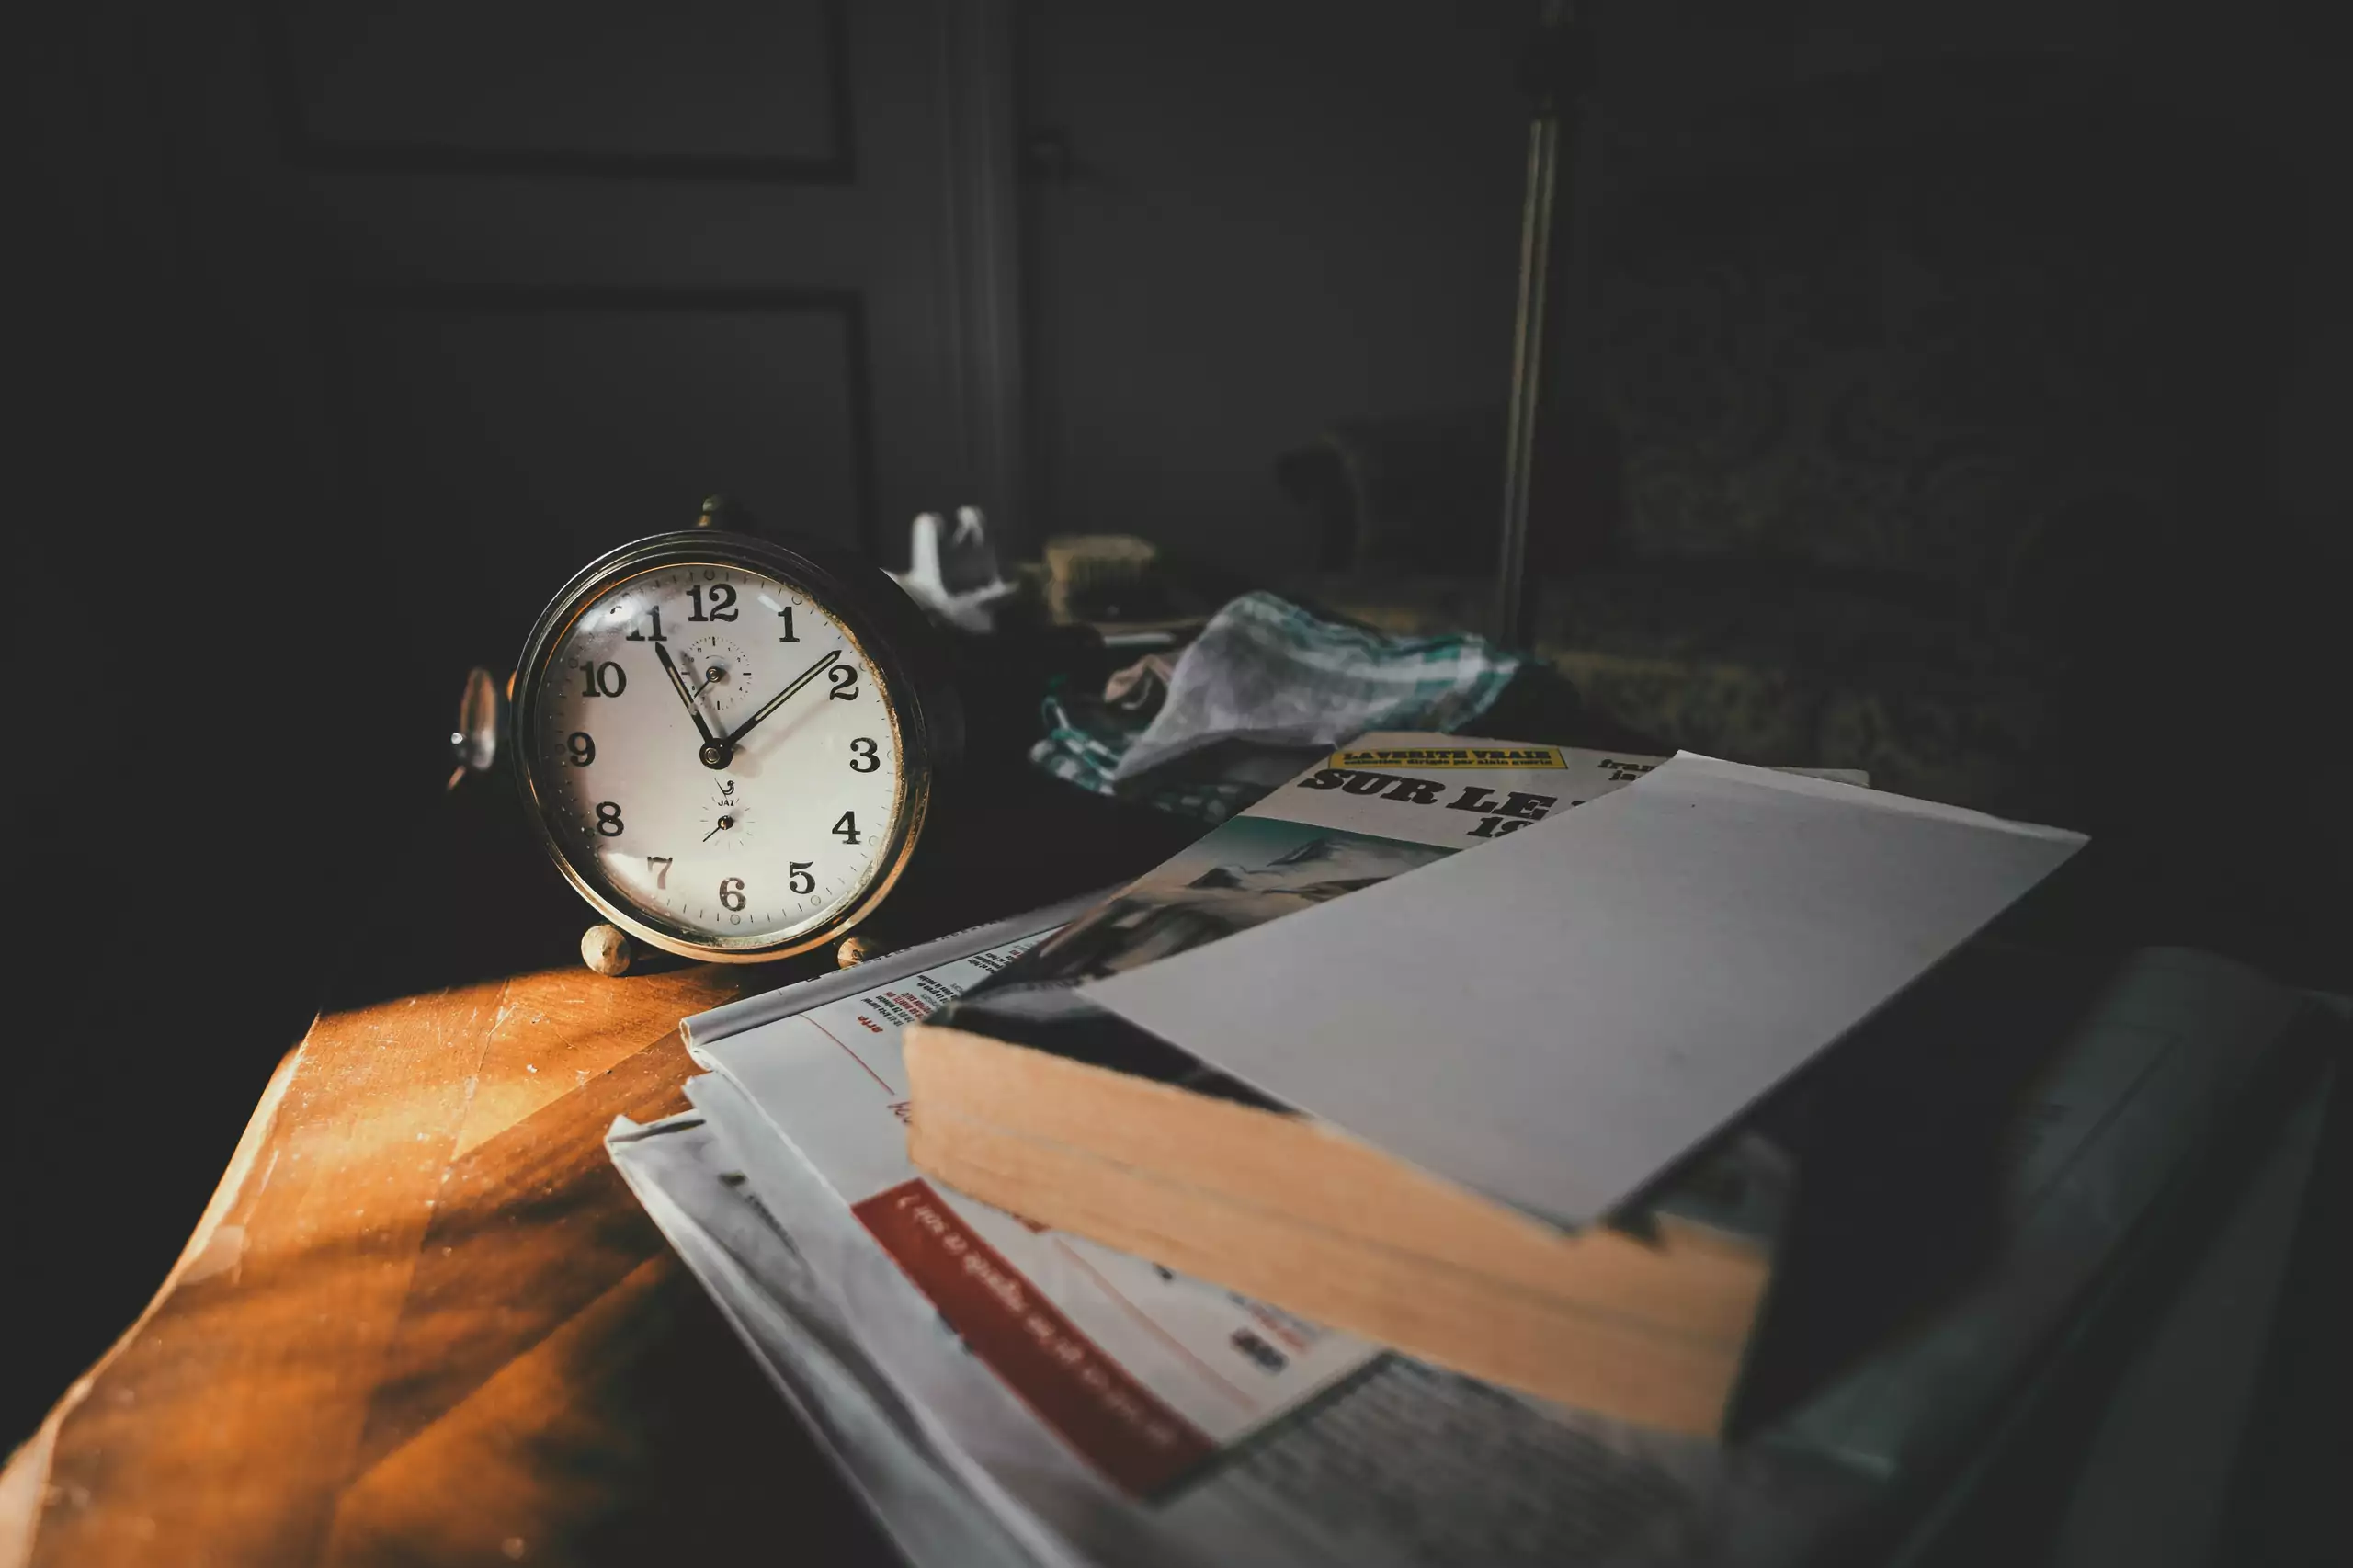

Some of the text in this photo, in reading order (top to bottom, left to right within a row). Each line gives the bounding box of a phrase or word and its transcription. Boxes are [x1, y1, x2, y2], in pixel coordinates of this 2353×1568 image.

[686, 584, 738, 622] 12
[777, 606, 800, 643] 1
[580, 661, 627, 698] 10
[828, 665, 859, 701] 2
[566, 732, 596, 767] 9
[849, 737, 881, 774] 3
[717, 799, 734, 807] JAZ
[1297, 767, 1558, 821] SUR LE
[595, 801, 625, 837] 8
[831, 810, 861, 845] 4
[647, 856, 673, 890] 7
[789, 861, 816, 894] 5
[719, 877, 746, 912] 6
